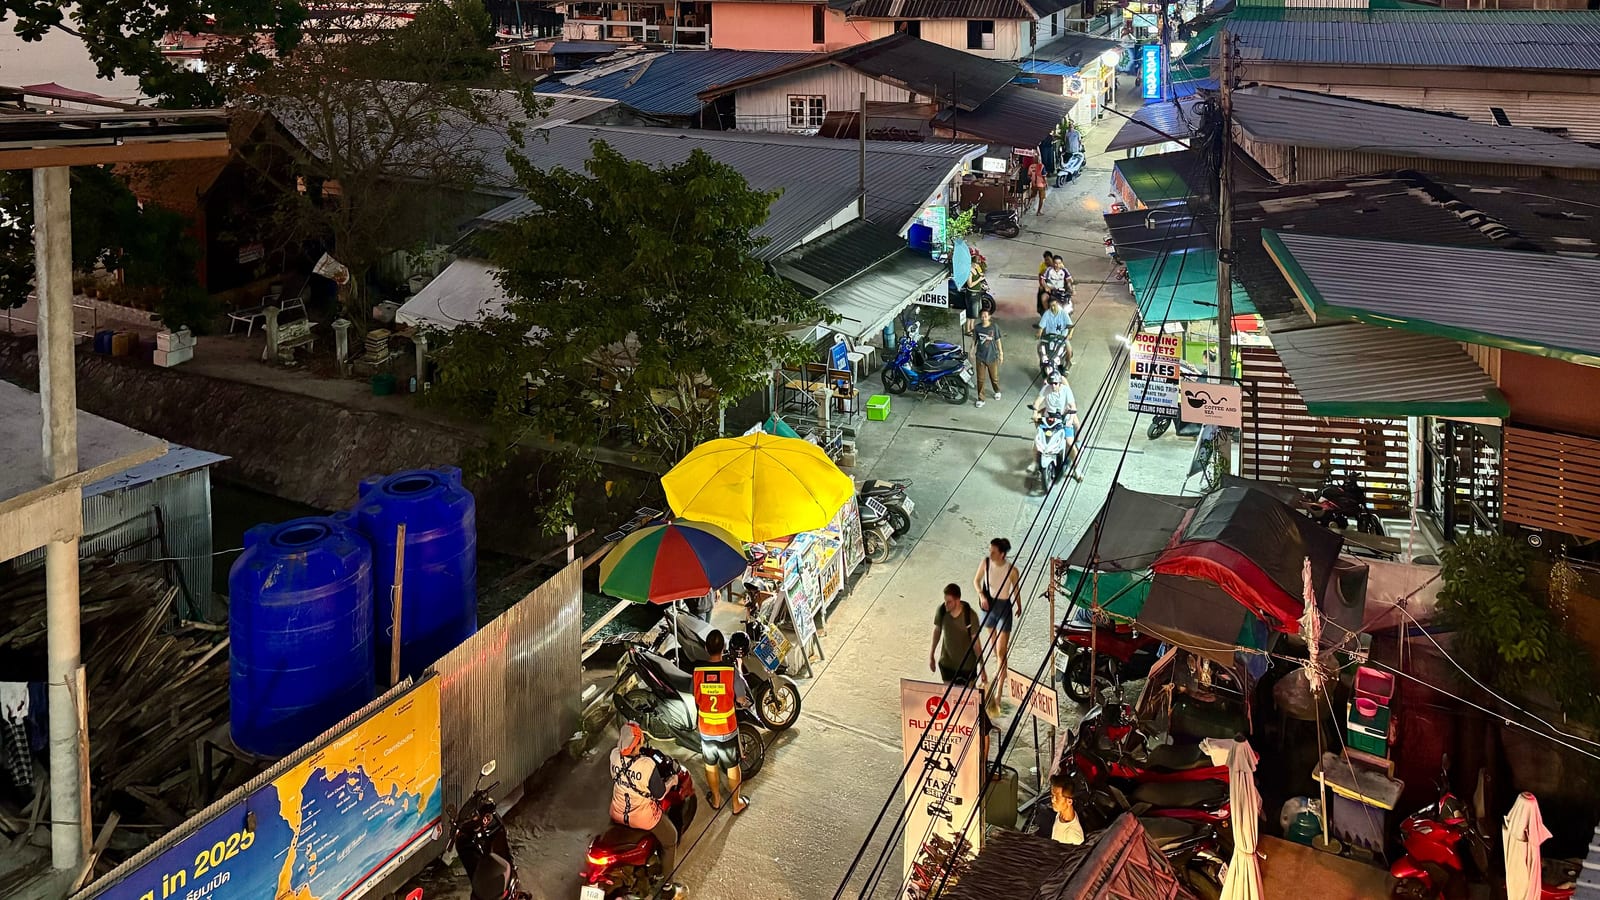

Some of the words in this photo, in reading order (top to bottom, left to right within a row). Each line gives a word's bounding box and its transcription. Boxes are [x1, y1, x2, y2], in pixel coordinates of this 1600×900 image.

[1135, 361, 1175, 377] BIKES
[709, 695, 718, 713] 2
[1010, 678, 1024, 701] BIKE
[1038, 691, 1054, 718] RENT
[163, 869, 186, 899] in
[194, 828, 255, 879] 2025
